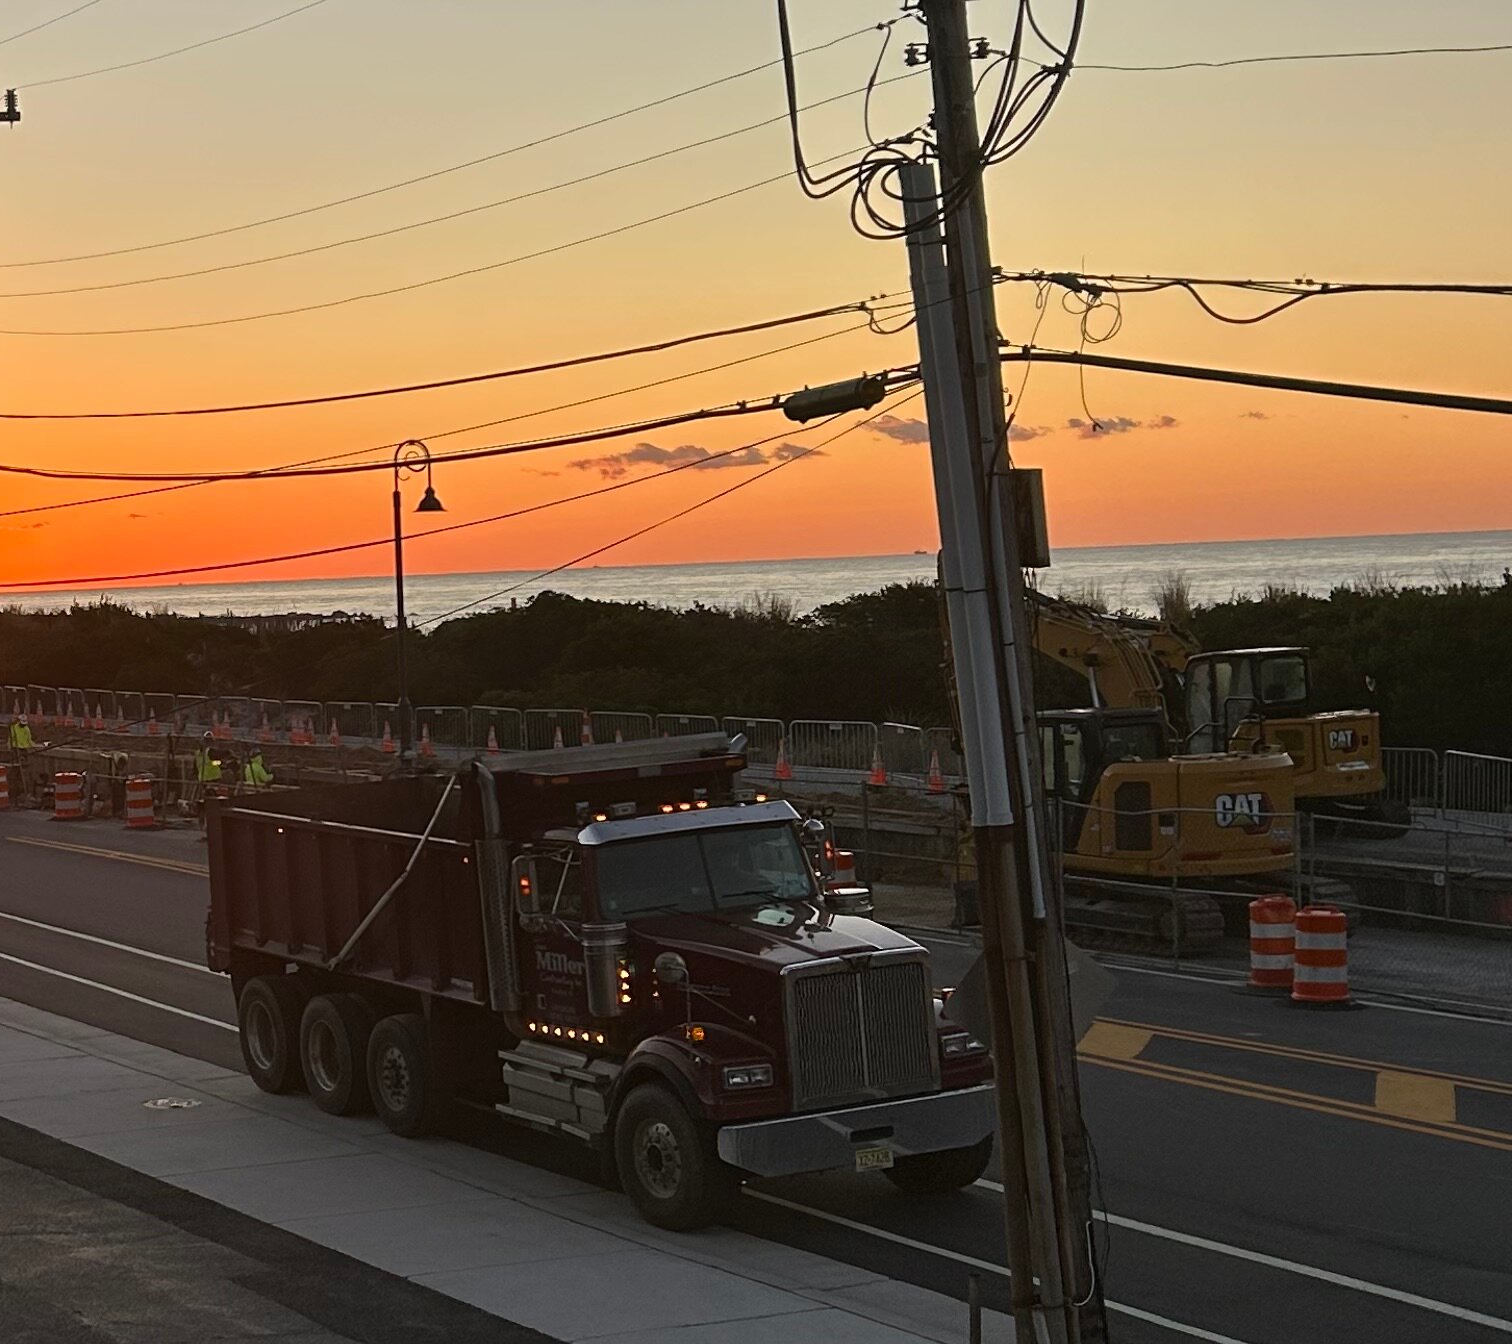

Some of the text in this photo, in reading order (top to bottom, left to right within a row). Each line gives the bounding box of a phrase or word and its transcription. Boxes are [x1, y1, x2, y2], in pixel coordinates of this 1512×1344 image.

[1329, 730, 1353, 750] CAT
[1215, 793, 1262, 827] CAT
[535, 950, 585, 975] Miller
